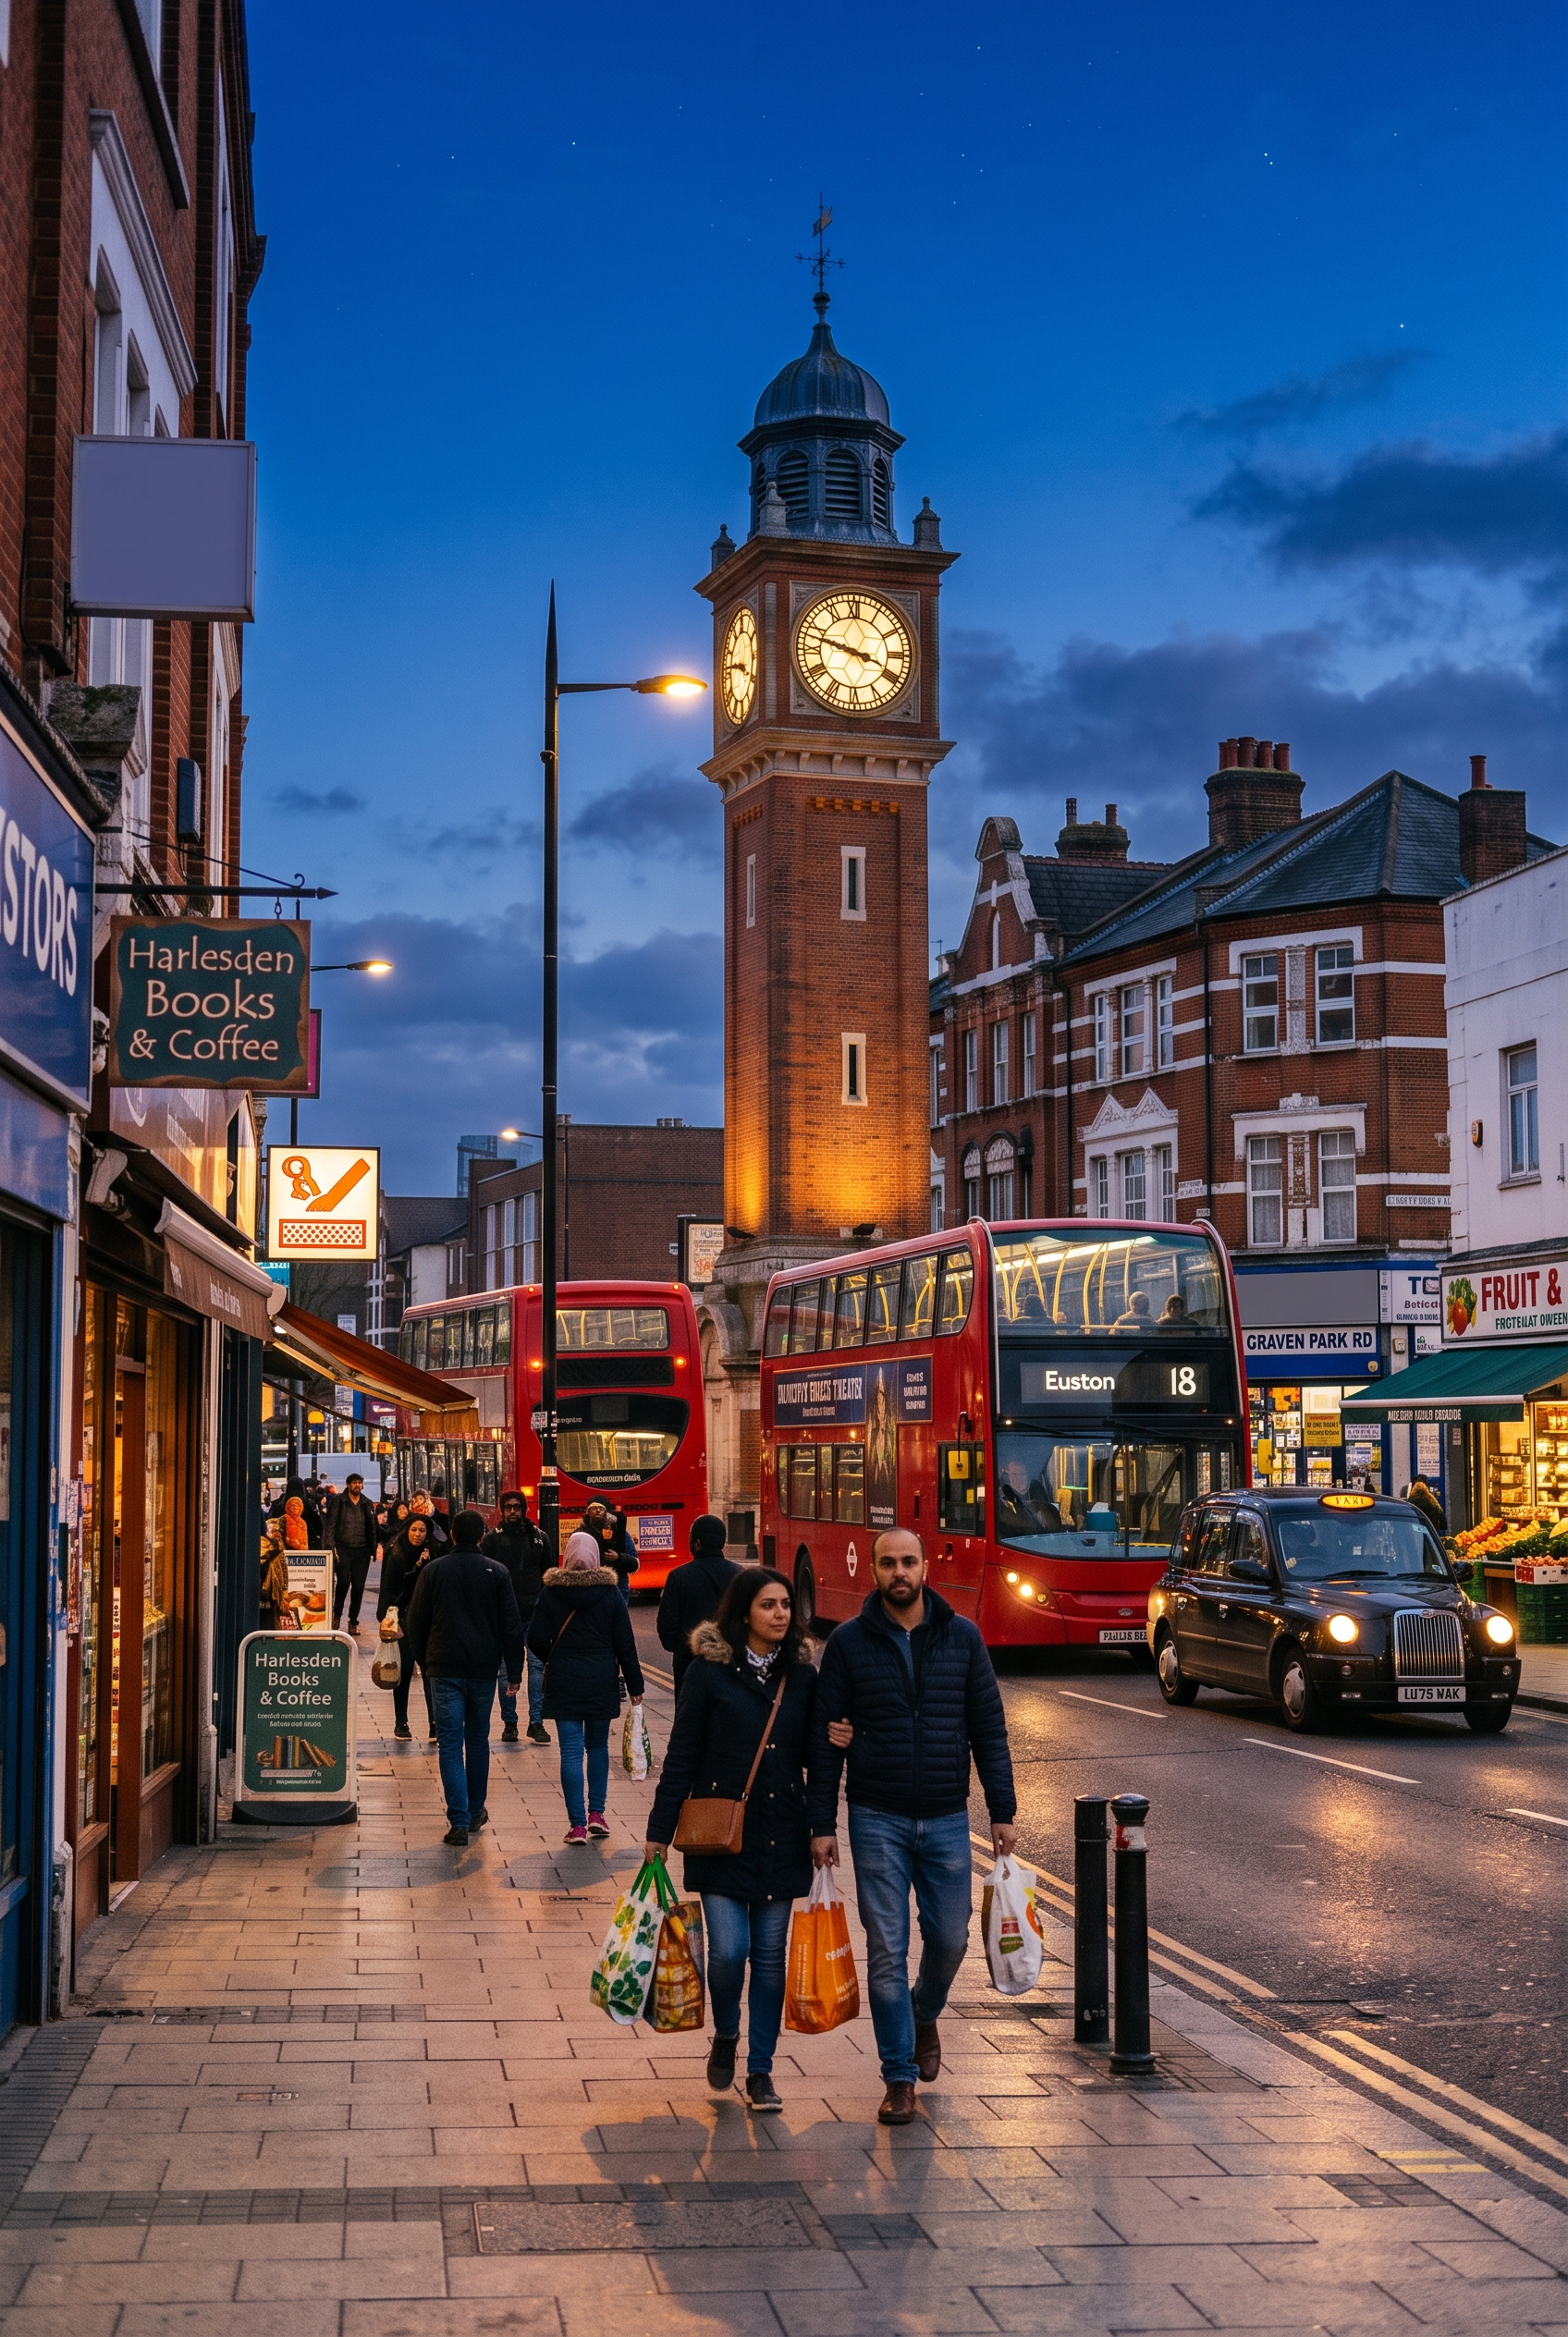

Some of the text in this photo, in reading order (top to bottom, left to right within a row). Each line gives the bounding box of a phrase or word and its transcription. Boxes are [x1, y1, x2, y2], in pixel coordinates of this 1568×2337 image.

[0, 805, 78, 997] STORS
[129, 935, 295, 975] Harlesden
[146, 978, 276, 1020] Books
[129, 1023, 279, 1060] & Coffee
[1481, 1267, 1562, 1312] FRUIT &
[1246, 1331, 1373, 1350] GRAVEN PARK RD
[1045, 1366, 1197, 1396] Euston 18
[255, 1652, 342, 1668] Harlesden
[268, 1671, 320, 1686] Books
[260, 1690, 332, 1706] & Coffee
[1404, 1688, 1460, 1700] LU75 NAK
